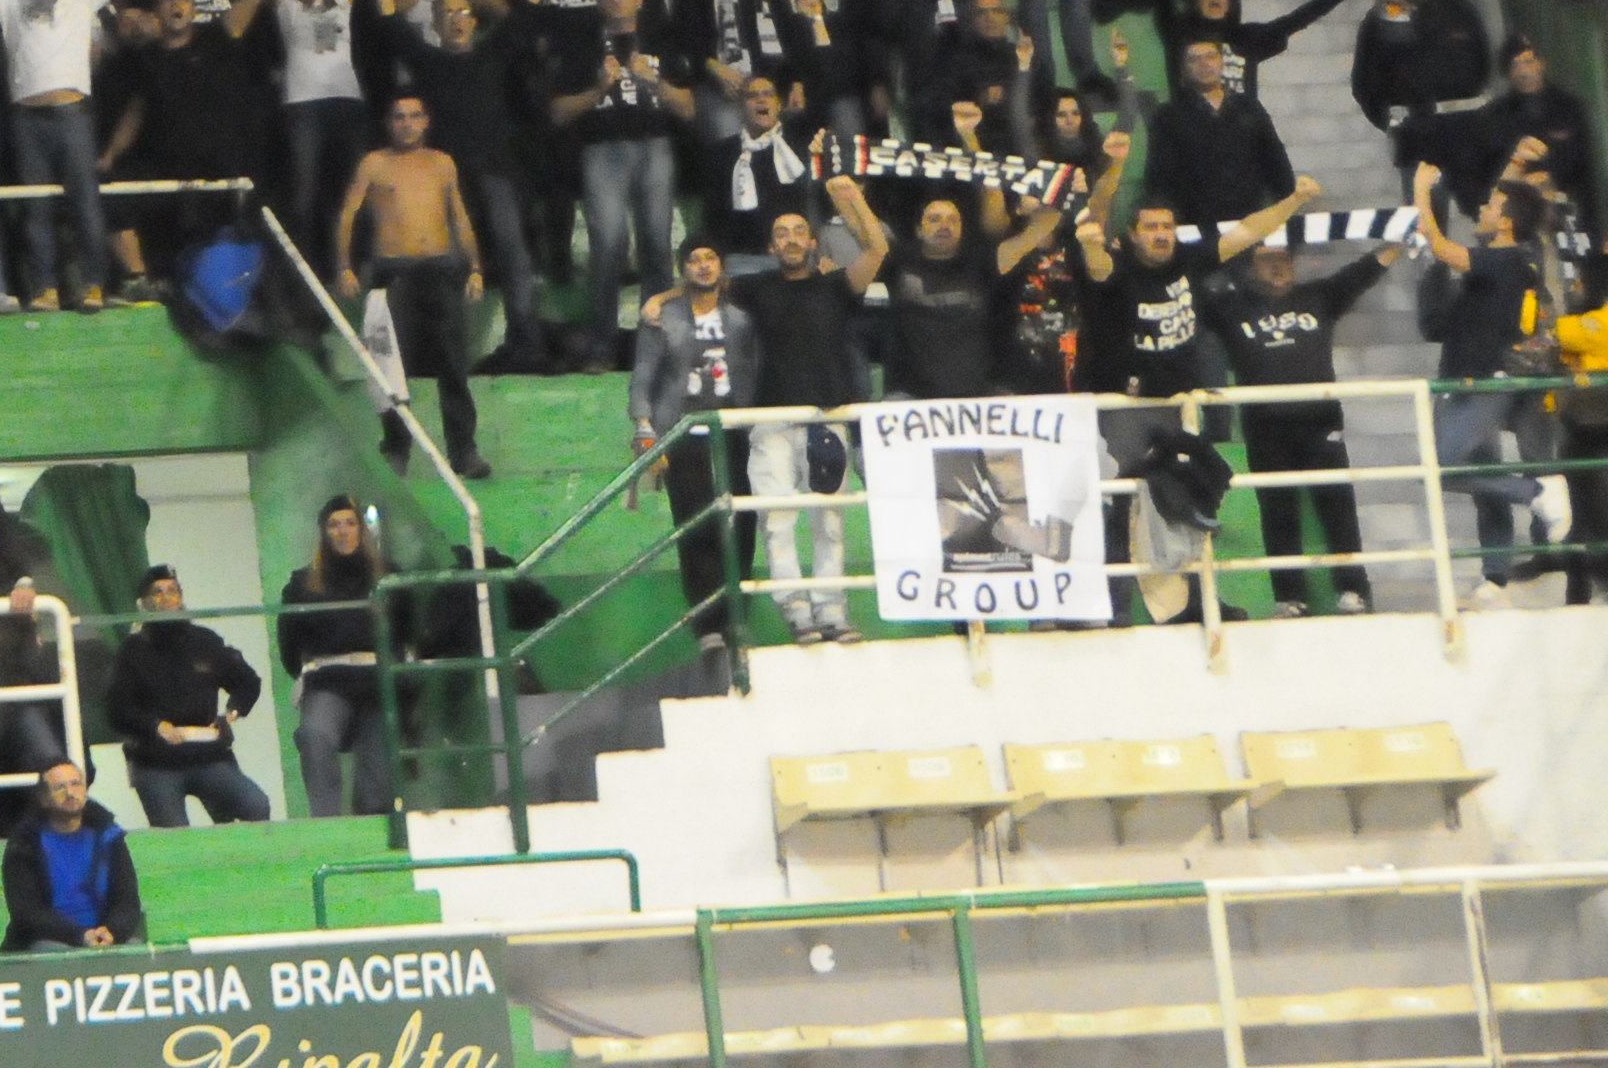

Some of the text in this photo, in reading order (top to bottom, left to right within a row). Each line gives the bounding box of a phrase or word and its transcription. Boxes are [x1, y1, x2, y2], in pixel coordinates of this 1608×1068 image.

[869, 145, 1044, 191] CASERTA
[896, 571, 1072, 614] GROUP
[44, 964, 251, 1025] PIZZERIA
[270, 947, 495, 1009] BRACERIA
